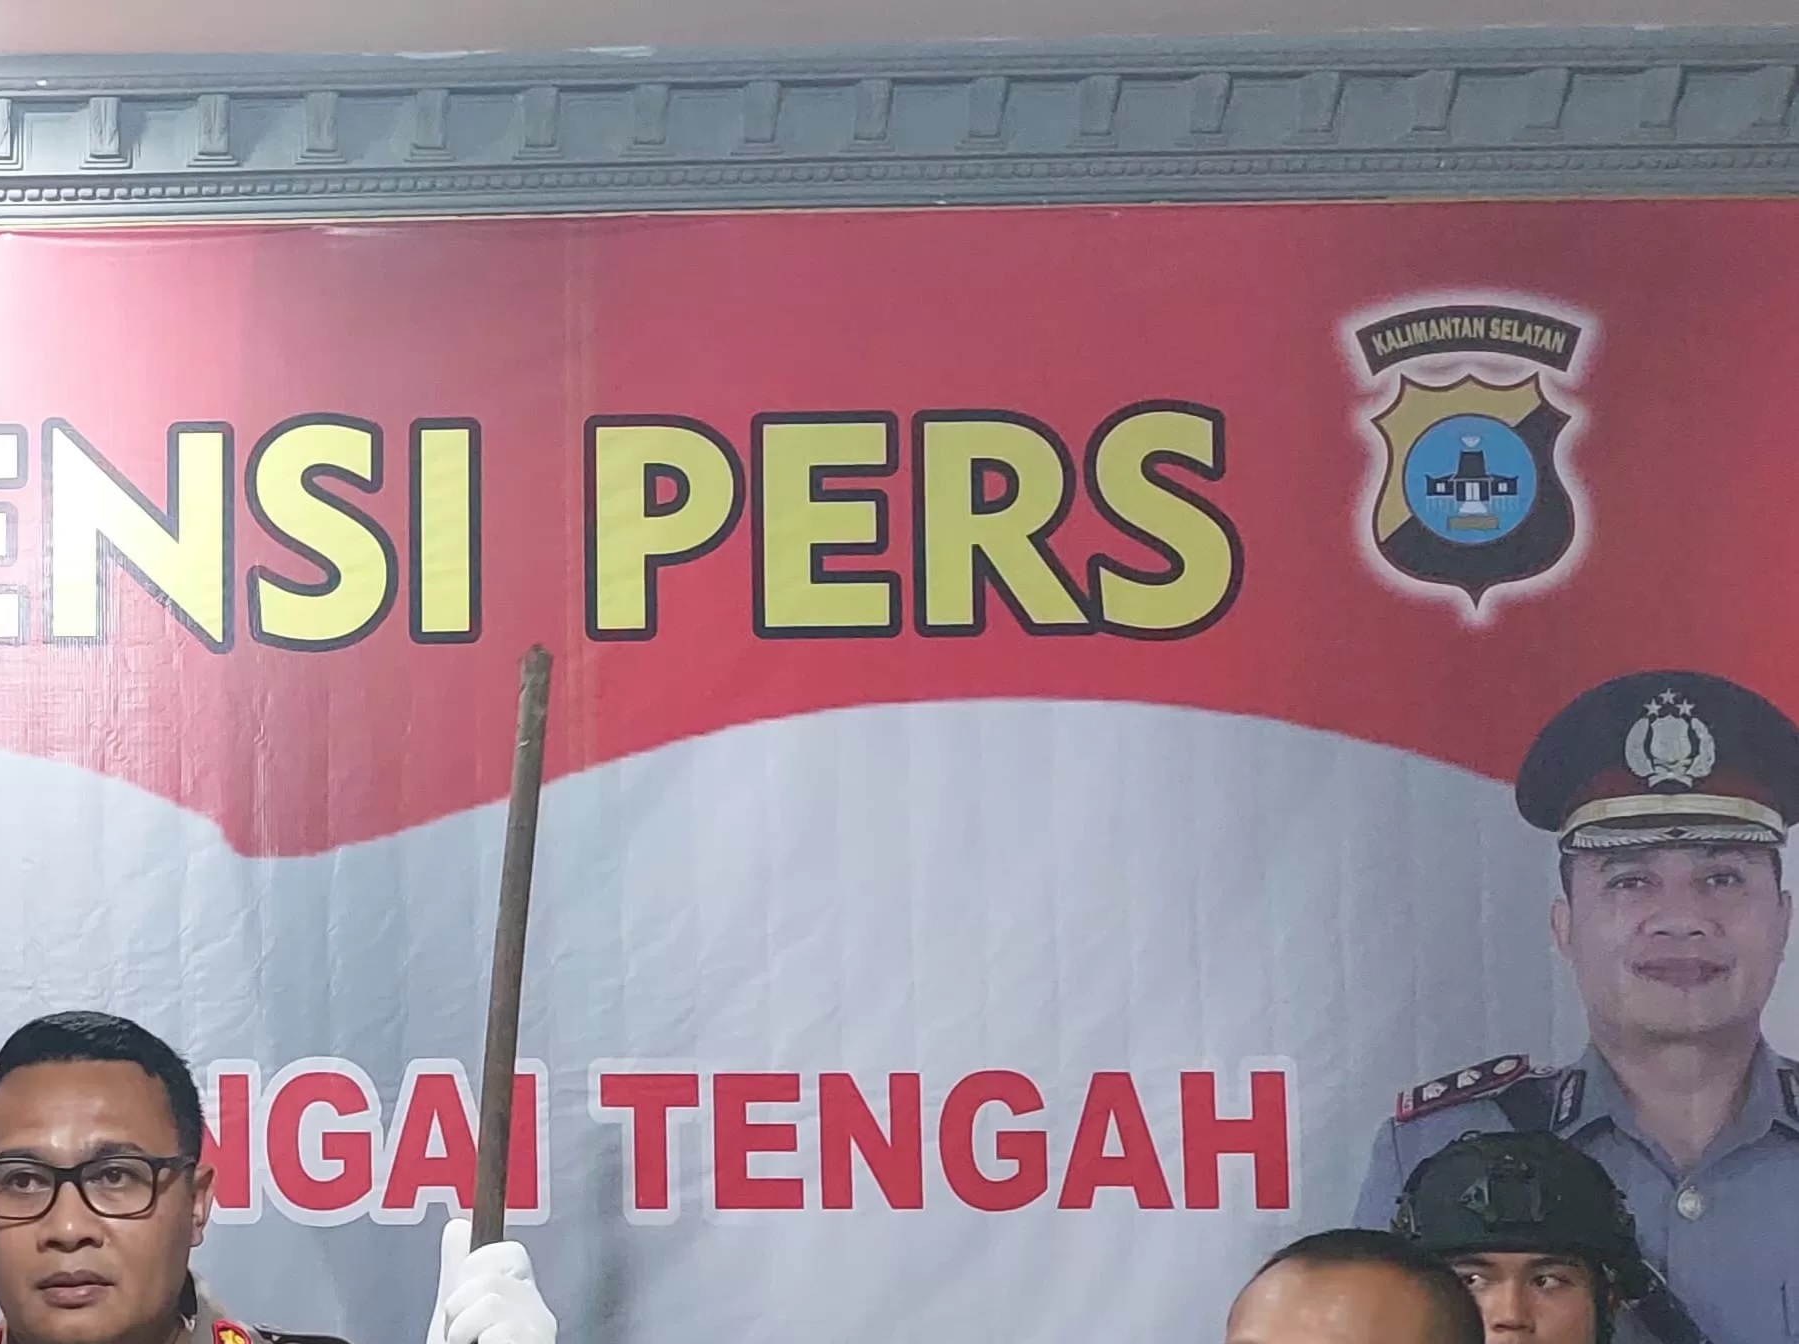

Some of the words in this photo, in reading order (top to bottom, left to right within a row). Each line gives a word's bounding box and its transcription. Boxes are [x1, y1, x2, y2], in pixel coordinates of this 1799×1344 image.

[1372, 316, 1485, 356] KALIMANTAN
[1489, 318, 1567, 353] SELATAN
[585, 401, 1244, 641] PERS
[600, 1070, 1291, 1212] TENGAH
